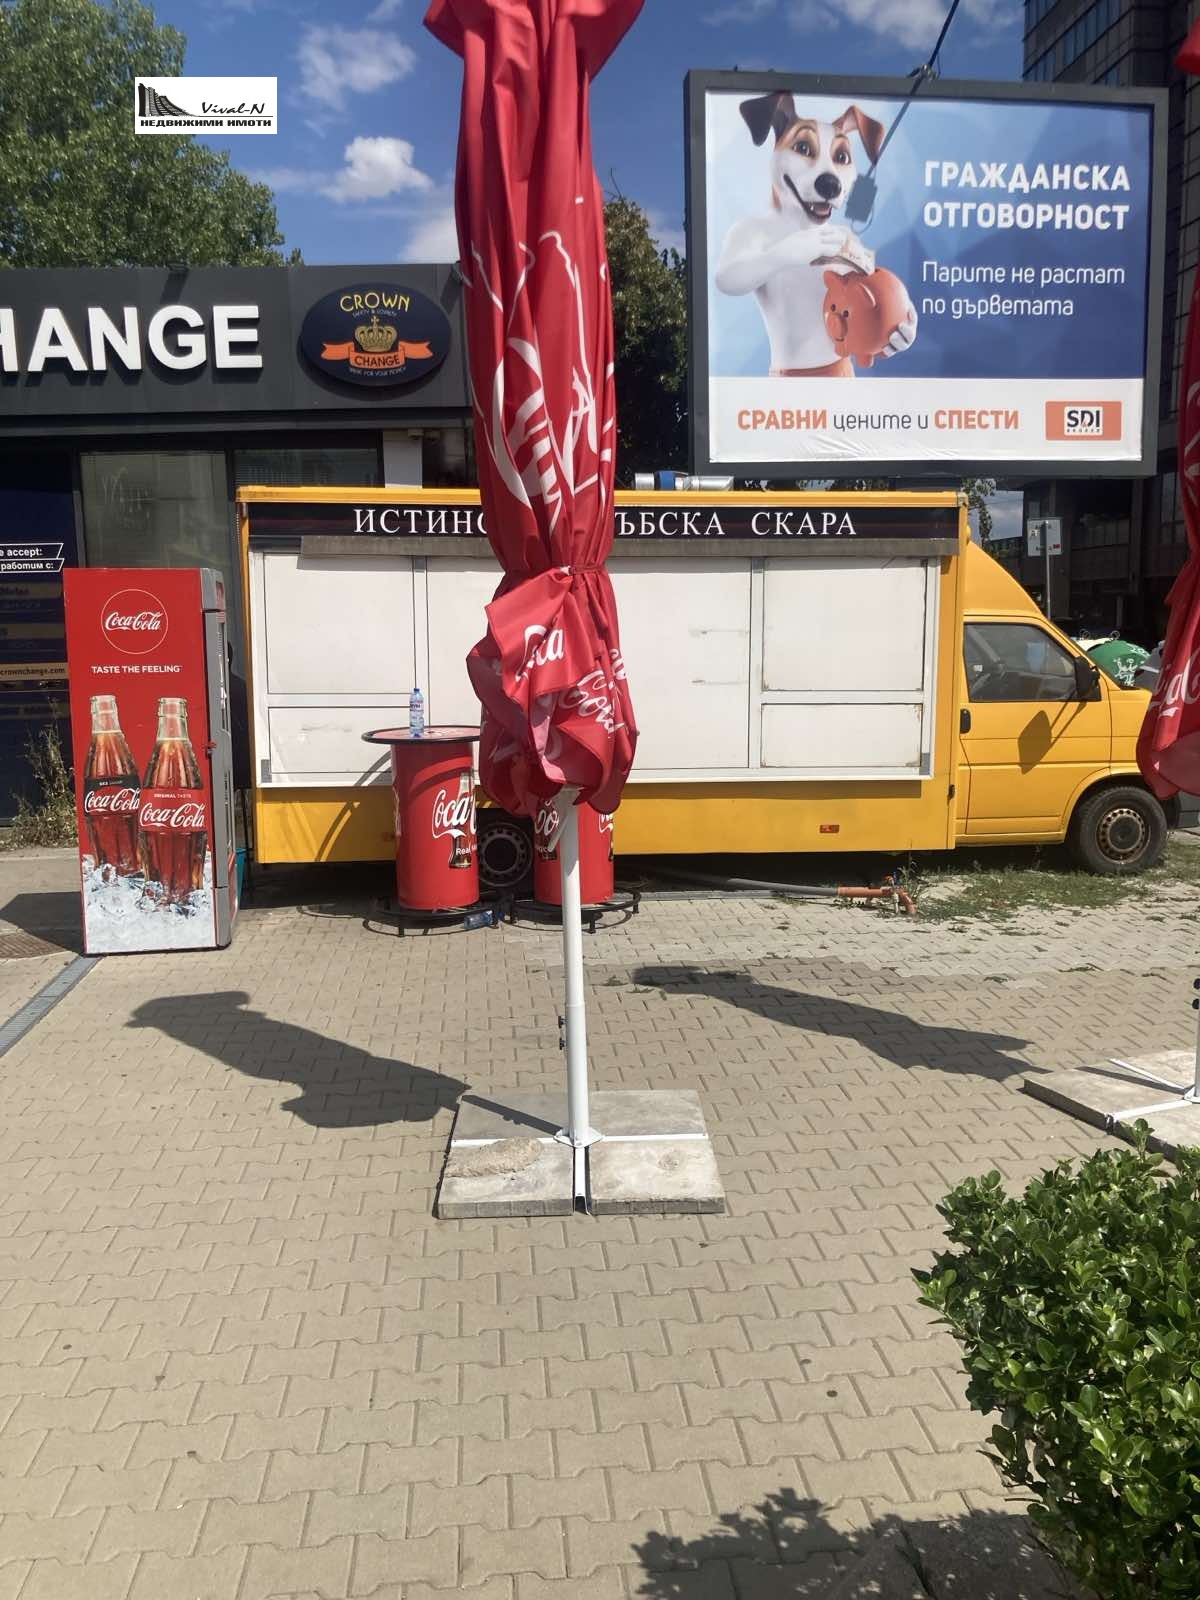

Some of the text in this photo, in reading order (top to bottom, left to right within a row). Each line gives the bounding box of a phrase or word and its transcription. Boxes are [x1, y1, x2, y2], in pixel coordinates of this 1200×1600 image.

[924, 160, 1131, 194] ГРАЖДАНСКА
[923, 201, 1130, 230] ОТГОВОРНОСТ
[922, 261, 1125, 288] Парите не растат
[340, 292, 410, 312] CROWN
[922, 294, 1074, 319] по дърветата
[354, 354, 401, 367] CHANGE
[737, 409, 1020, 432] СРАВНИ цените и СПЕСТИ
[1067, 409, 1100, 428] SDI
[615, 511, 726, 536] ЪБСКА
[751, 511, 857, 536] СКАРА
[7, 547, 43, 558] accept:
[1, 561, 44, 572] работим
[105, 611, 164, 631] Coca-Cola
[91, 665, 181, 674] TASTE THE FEELING
[140, 802, 206, 828] Coca-Cola
